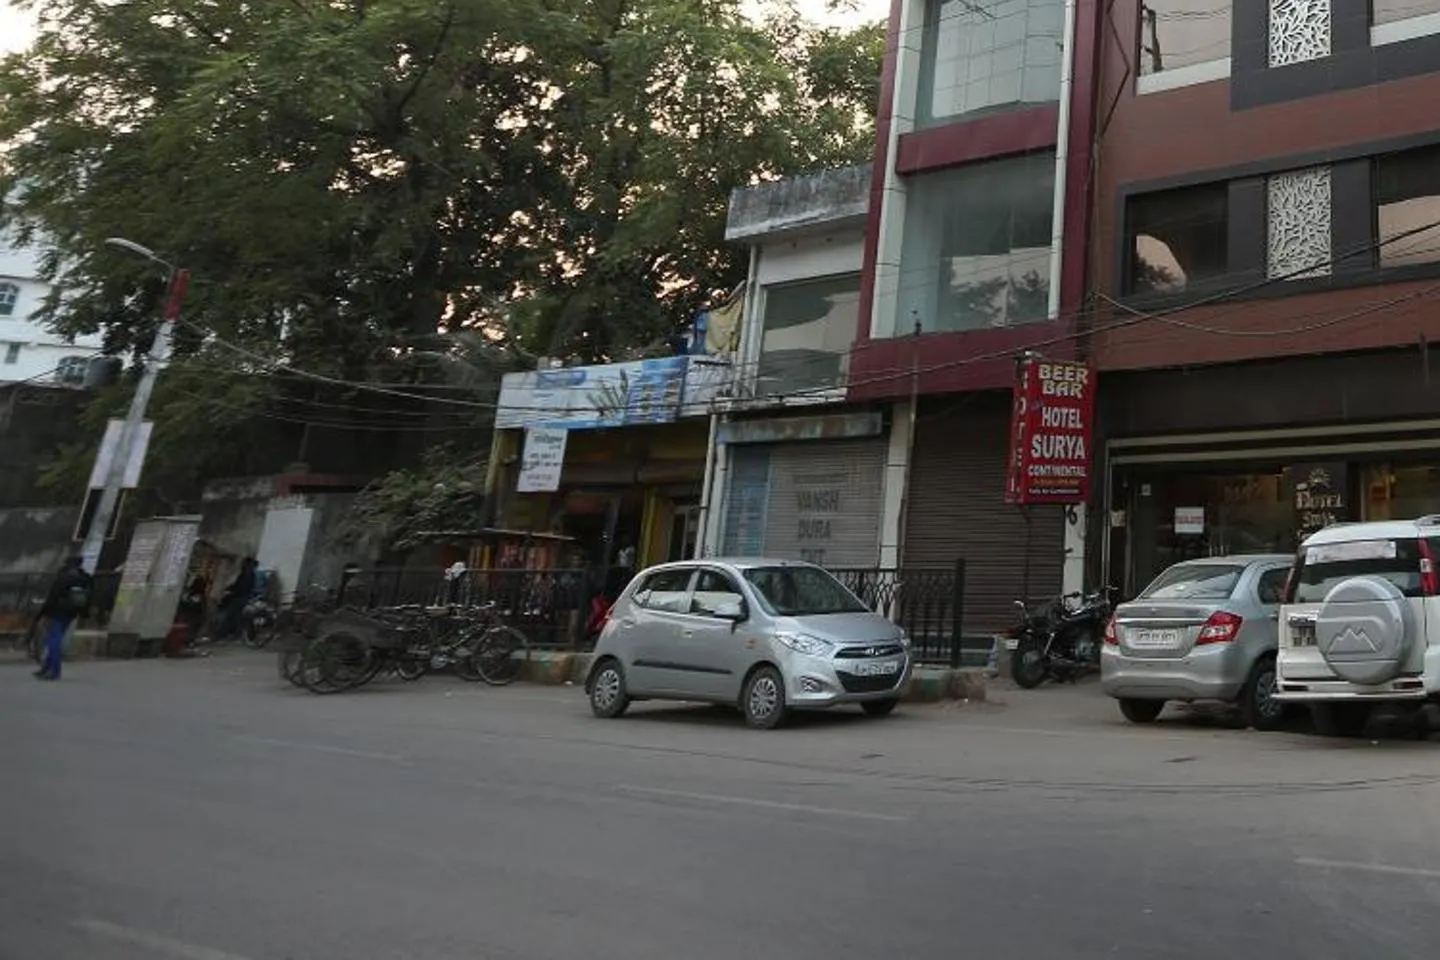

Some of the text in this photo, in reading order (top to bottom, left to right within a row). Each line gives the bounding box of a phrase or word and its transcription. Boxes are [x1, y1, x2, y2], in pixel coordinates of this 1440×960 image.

[1038, 364, 1089, 385] BEER
[1042, 381, 1083, 400] BAR
[1041, 407, 1084, 428] HOTEL
[1031, 434, 1086, 460] SURYA
